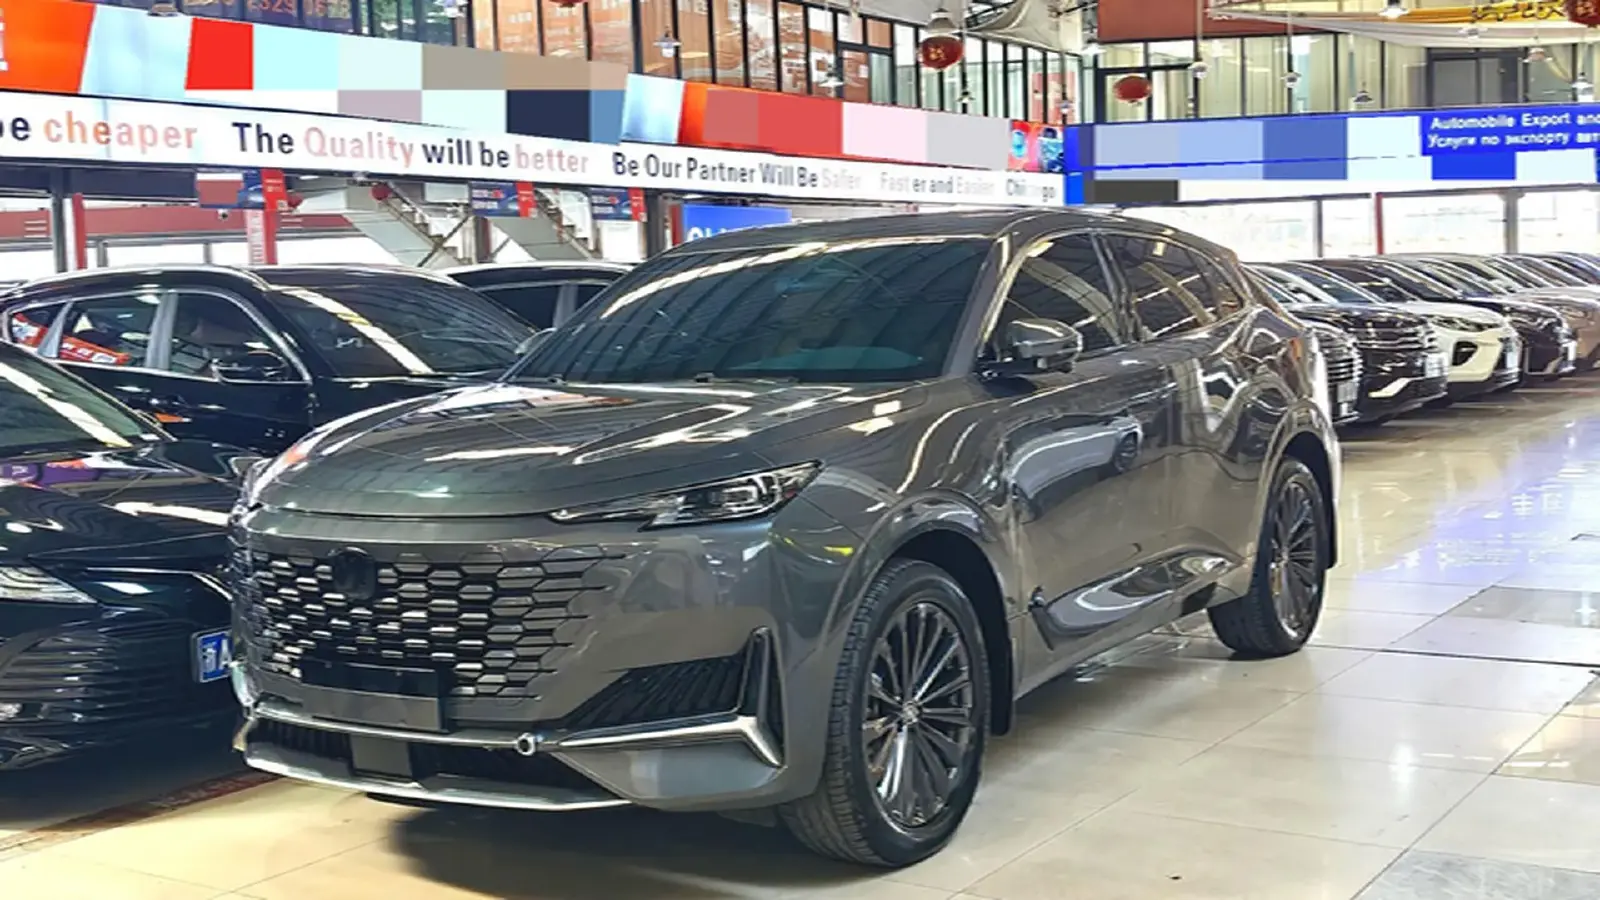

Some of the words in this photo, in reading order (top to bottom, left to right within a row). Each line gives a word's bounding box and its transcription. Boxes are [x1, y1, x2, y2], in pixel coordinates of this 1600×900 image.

[0, 117, 31, 141] e
[43, 110, 198, 155] cheaper
[1430, 113, 1516, 130] Automobile
[1521, 112, 1571, 128] Export
[231, 122, 294, 154] The
[303, 126, 414, 168] Quality
[421, 138, 473, 166] will
[478, 141, 510, 168] be
[514, 143, 589, 173] better
[1481, 135, 1500, 145] по
[612, 151, 639, 176] Be
[644, 153, 681, 178] Our
[687, 156, 755, 184] Partner
[758, 162, 794, 187] Will
[797, 166, 818, 188] Be
[821, 166, 861, 190] Safer
[929, 176, 953, 194] and
